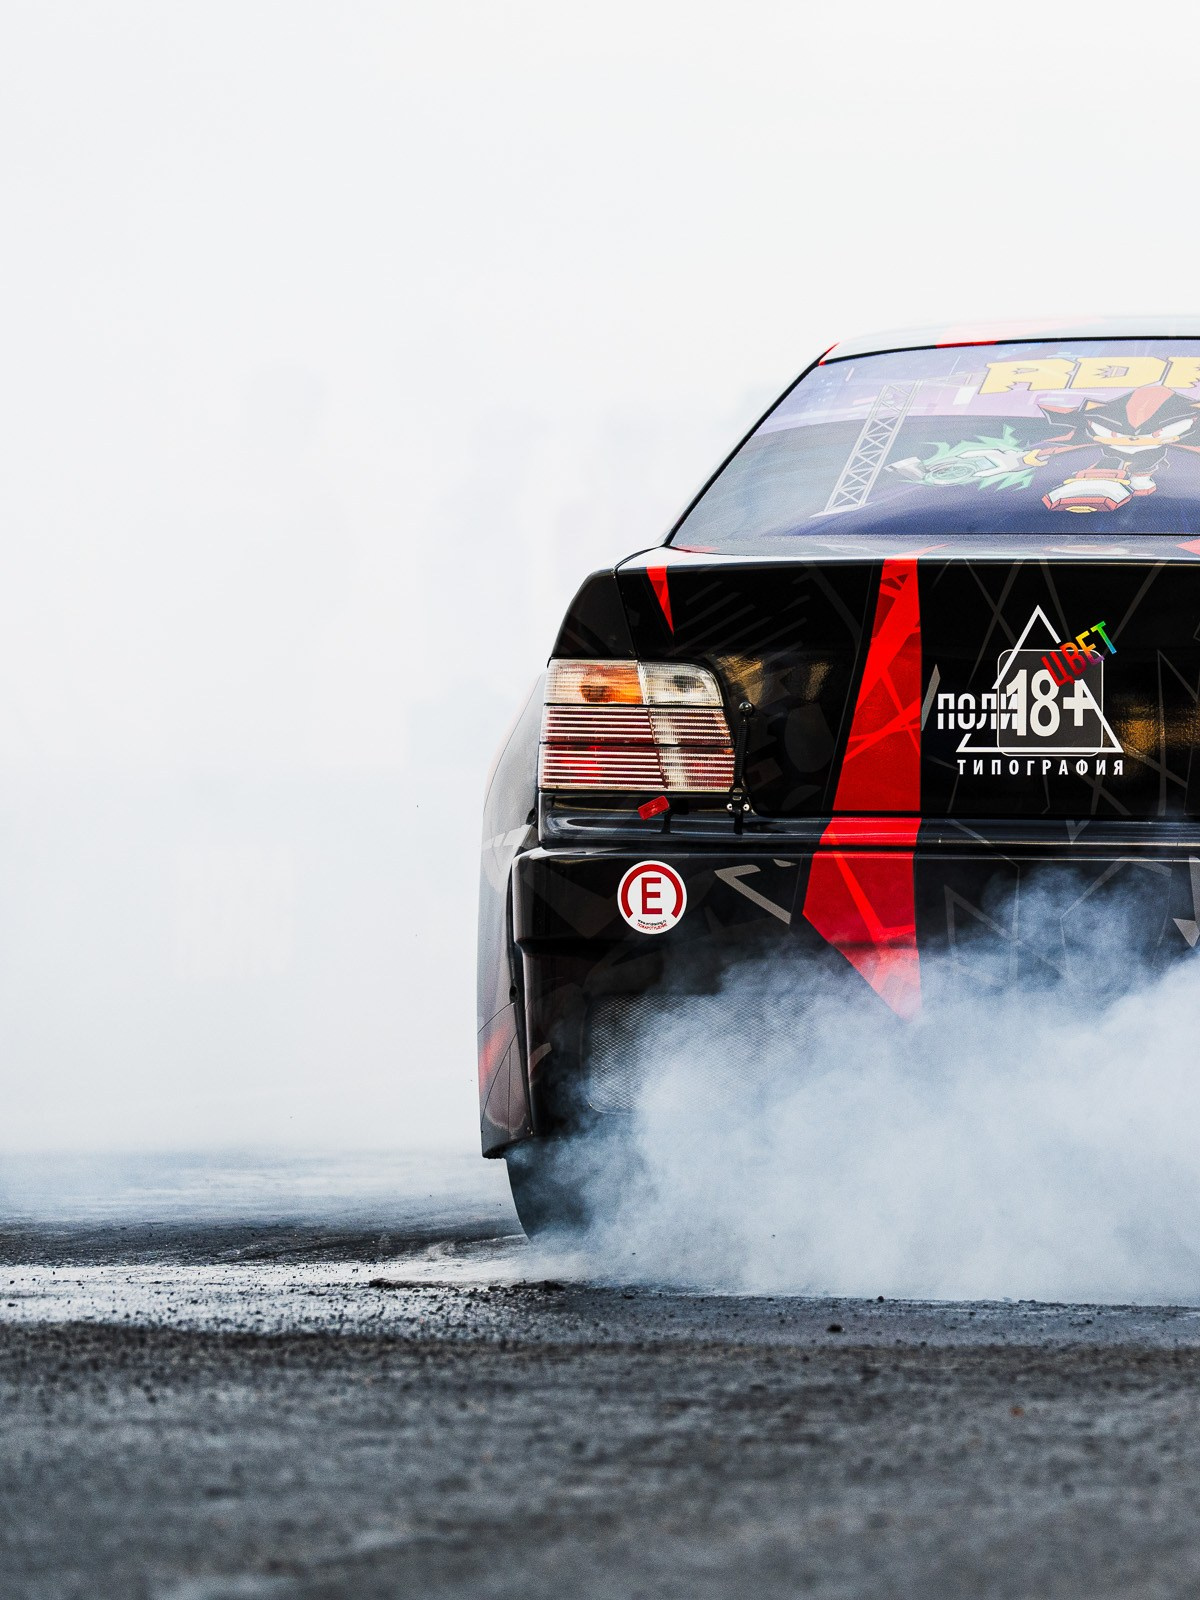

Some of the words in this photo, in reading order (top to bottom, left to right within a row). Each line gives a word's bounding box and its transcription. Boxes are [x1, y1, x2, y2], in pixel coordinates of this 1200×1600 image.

[1041, 620, 1117, 687] ЦВЕТ
[937, 693, 1018, 730] ПОЛИ
[1006, 669, 1096, 737] 18+
[957, 759, 1124, 776] ТИПОГРАФИЯ
[641, 877, 662, 914] E
